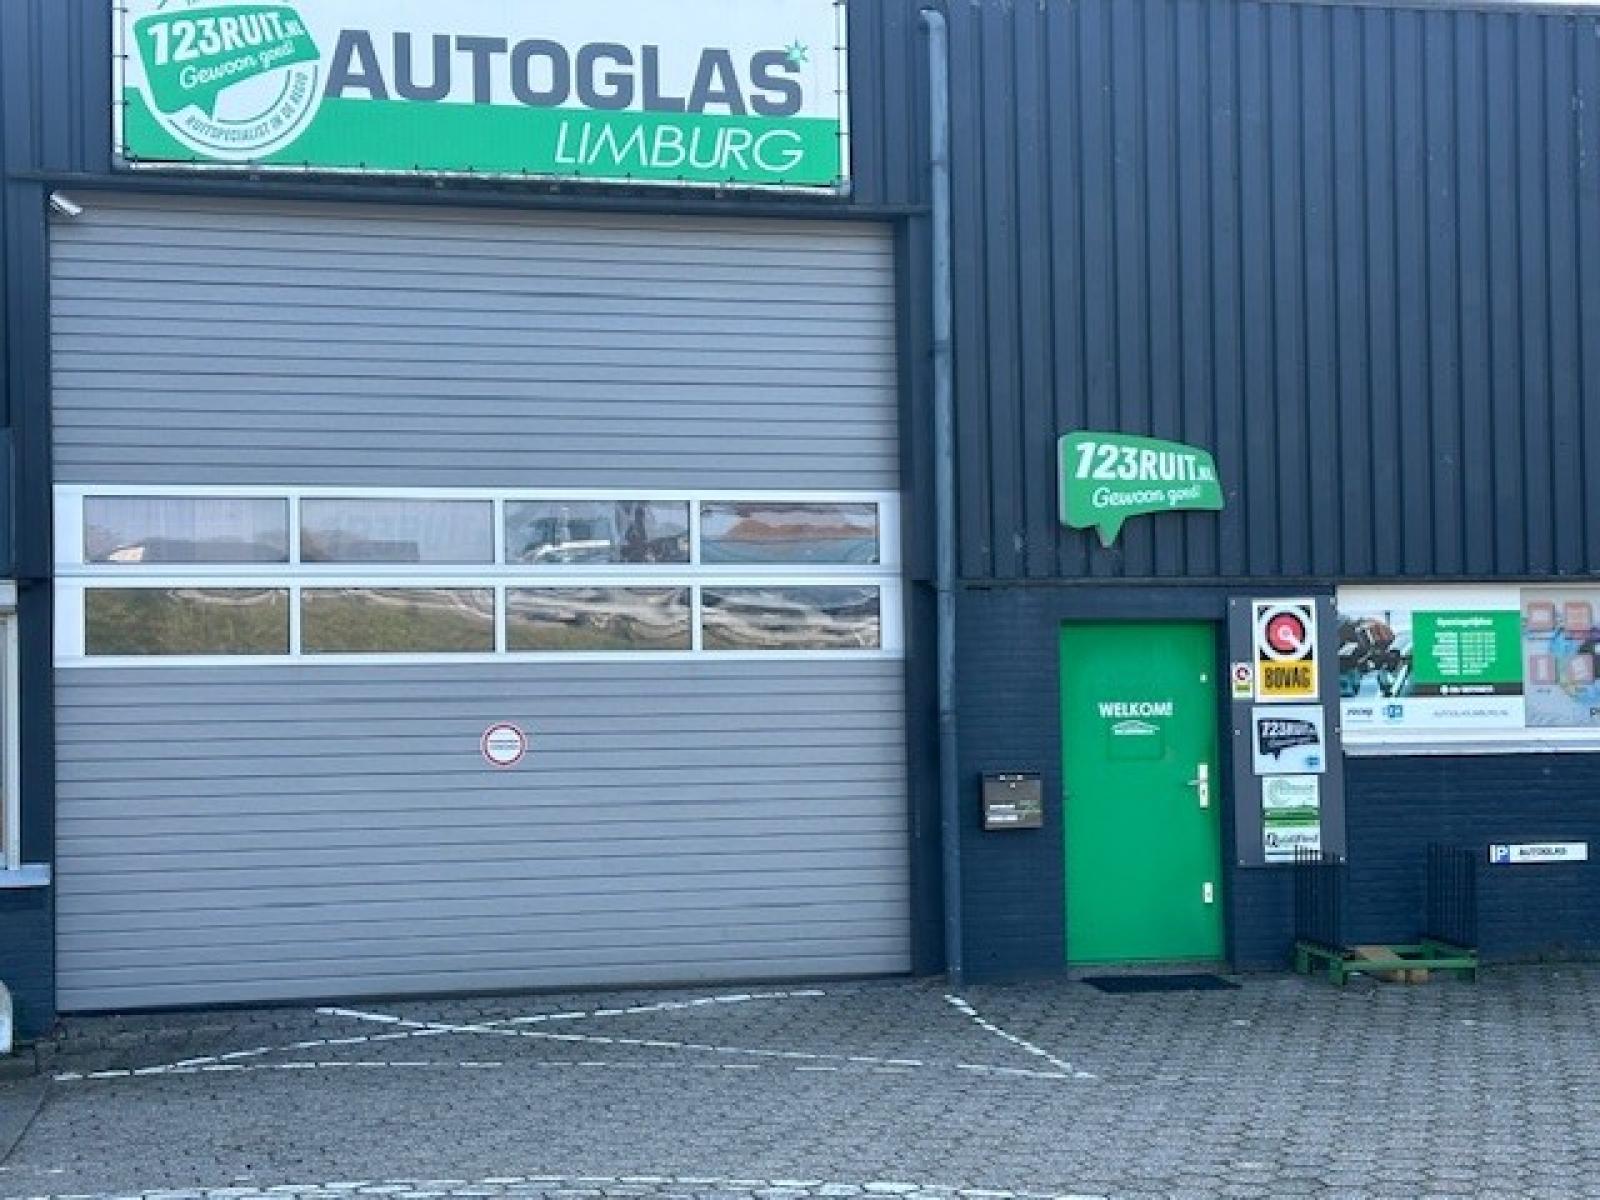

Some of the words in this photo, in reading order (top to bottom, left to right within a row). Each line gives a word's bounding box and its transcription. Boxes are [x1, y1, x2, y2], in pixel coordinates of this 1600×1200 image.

[179, 54, 257, 89] Gewoon
[323, 30, 803, 117] AUTOGLAS
[554, 120, 805, 171] LIMBURG
[1091, 486, 1165, 508] Gewoon
[1264, 666, 1311, 689] BOVAG
